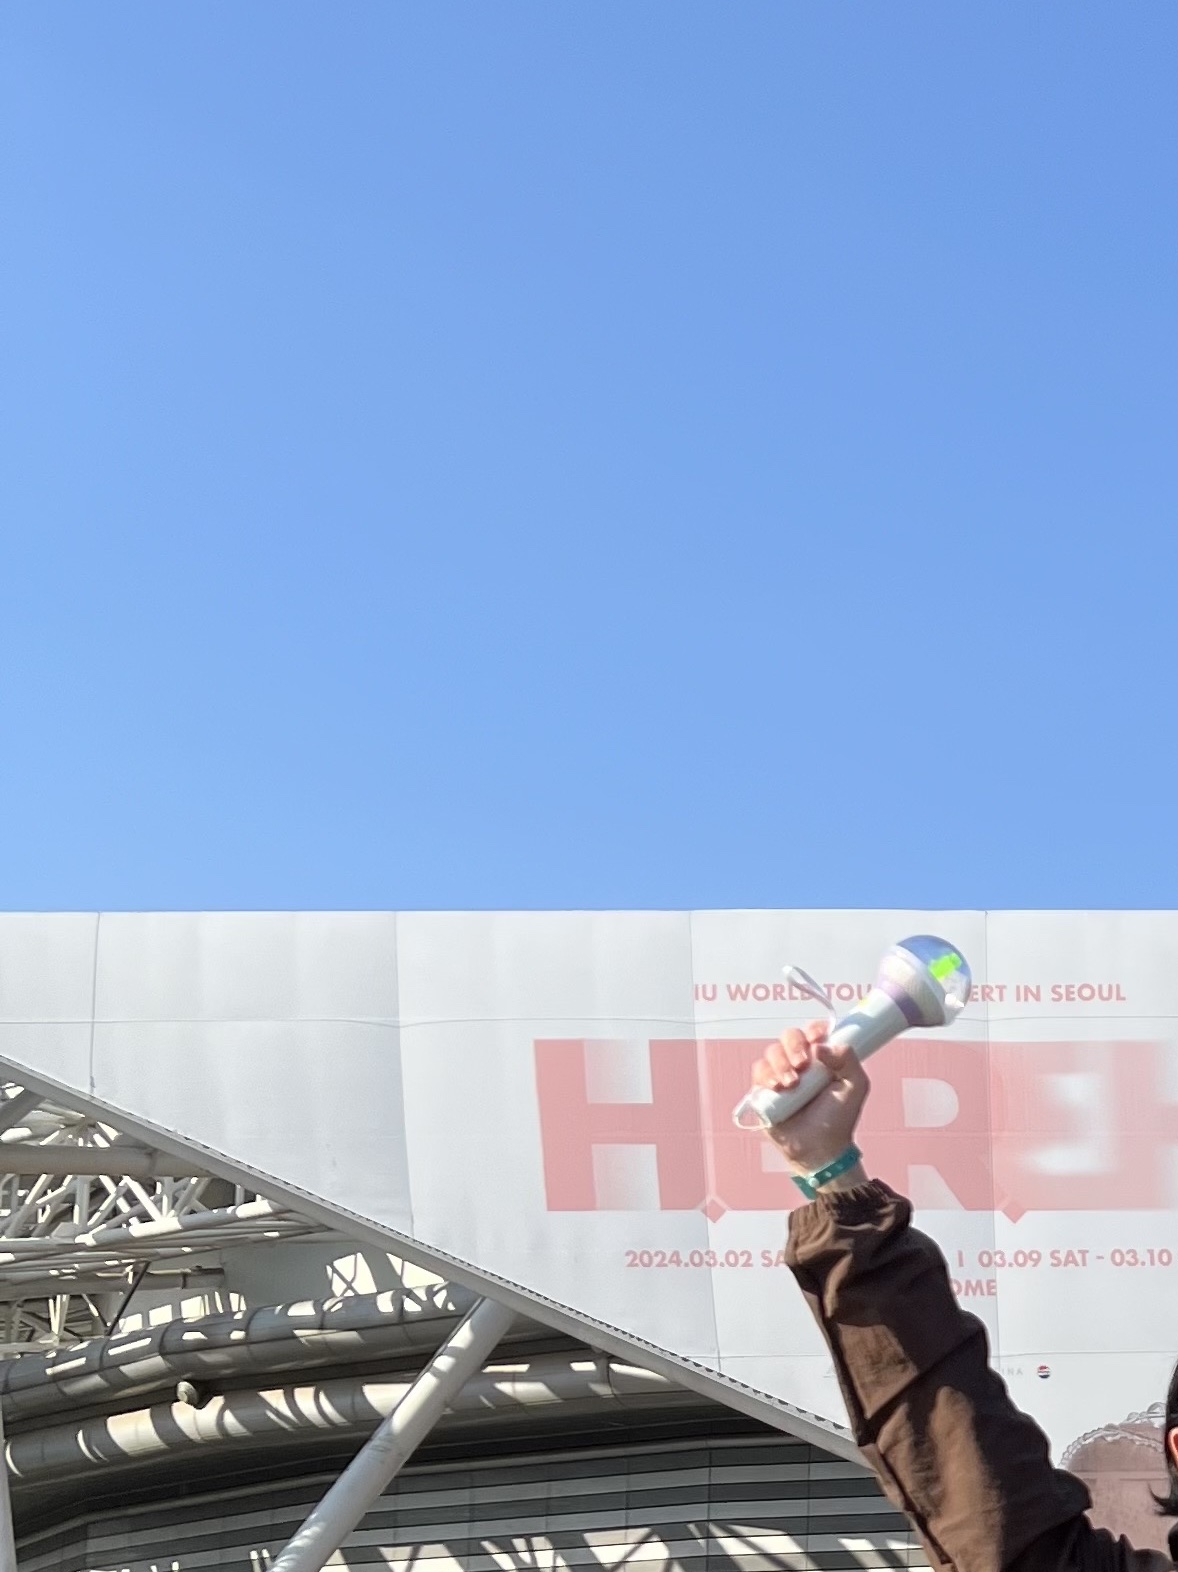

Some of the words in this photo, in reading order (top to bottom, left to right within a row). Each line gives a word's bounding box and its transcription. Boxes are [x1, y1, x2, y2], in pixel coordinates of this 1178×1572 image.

[694, 983, 717, 1001] IU
[1016, 984, 1041, 1002] IN
[1051, 983, 1126, 1001] SEOUL
[625, 1249, 753, 1268] 2024.03.02
[761, 1249, 790, 1268] SA
[978, 1249, 1042, 1268] 03.09
[1050, 1249, 1090, 1267] SAT
[1110, 1248, 1173, 1267] 03.10
[950, 1279, 997, 1296] OME
